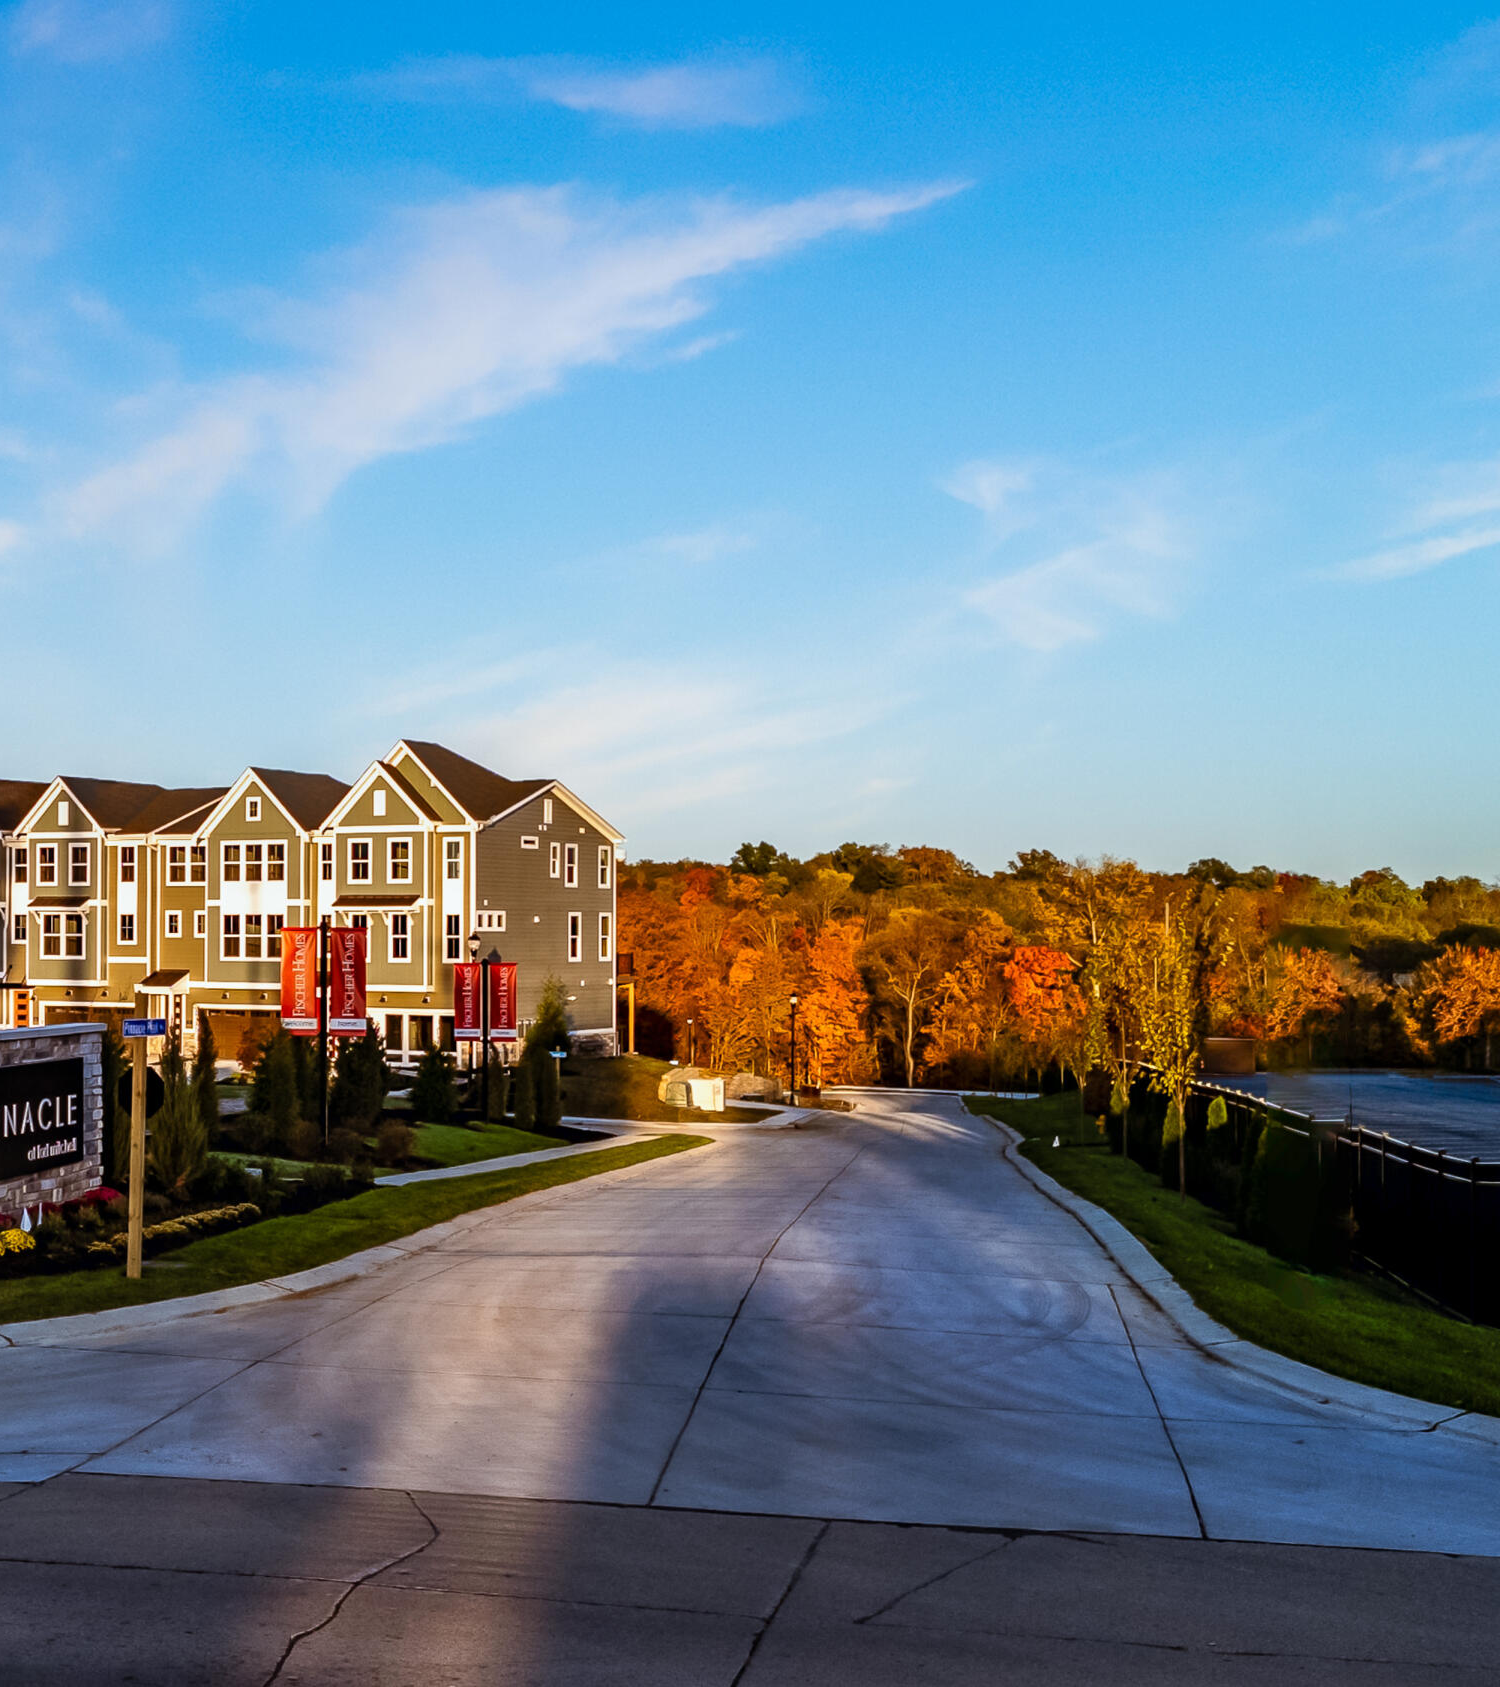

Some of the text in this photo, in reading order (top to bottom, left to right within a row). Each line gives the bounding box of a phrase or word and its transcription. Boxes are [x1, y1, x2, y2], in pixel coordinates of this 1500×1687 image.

[292, 933, 306, 1017] FISCHER HOMES
[342, 933, 356, 1017] FISCHER HOMES
